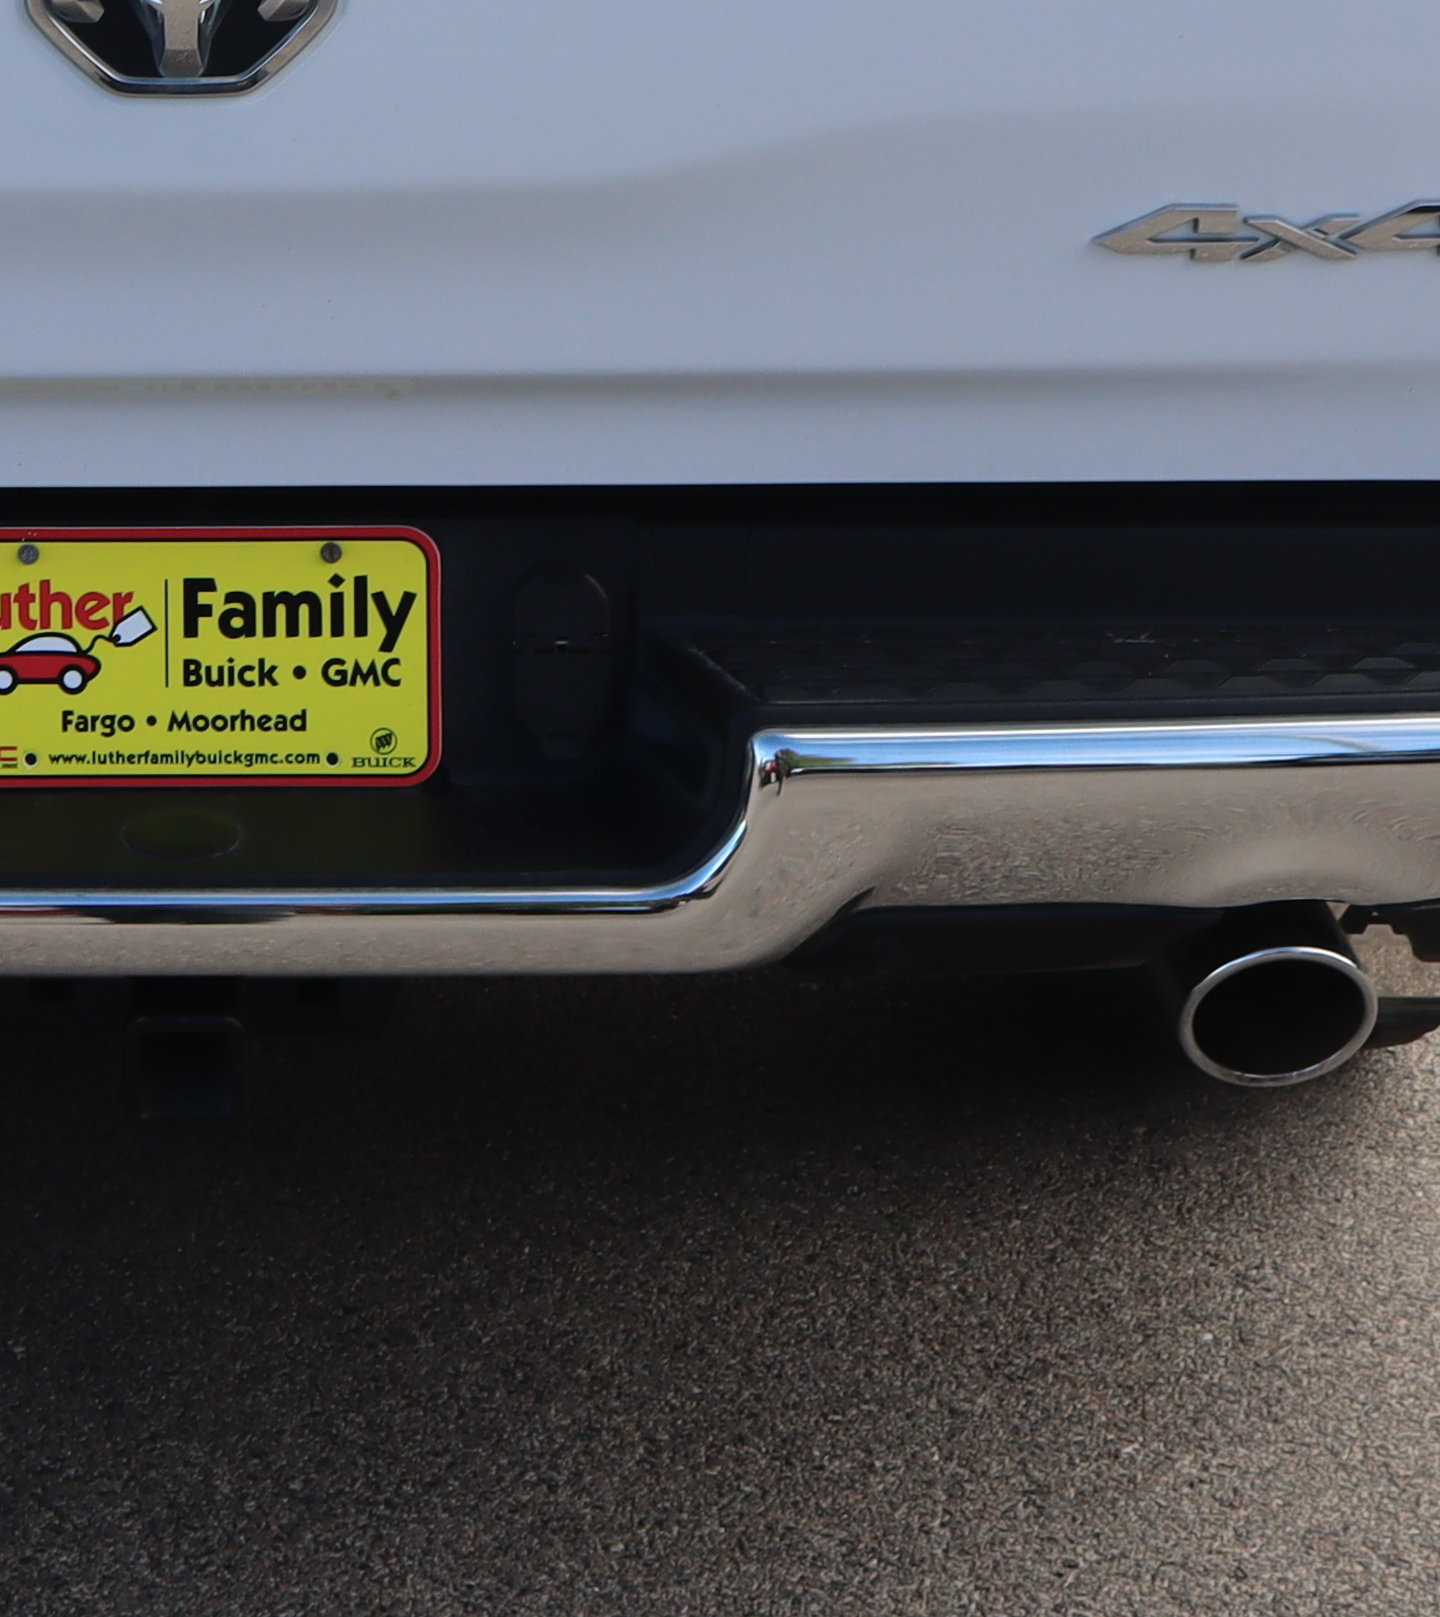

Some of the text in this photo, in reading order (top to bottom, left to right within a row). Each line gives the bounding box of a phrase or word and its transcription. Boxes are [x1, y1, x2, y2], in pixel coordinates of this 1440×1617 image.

[182, 572, 418, 654] Family
[182, 656, 403, 688] Buick GMC
[61, 709, 308, 738] Fargo Moorhead
[48, 749, 320, 767] www.lutherfamilybuickgmc.com
[351, 757, 417, 769] BUICK
